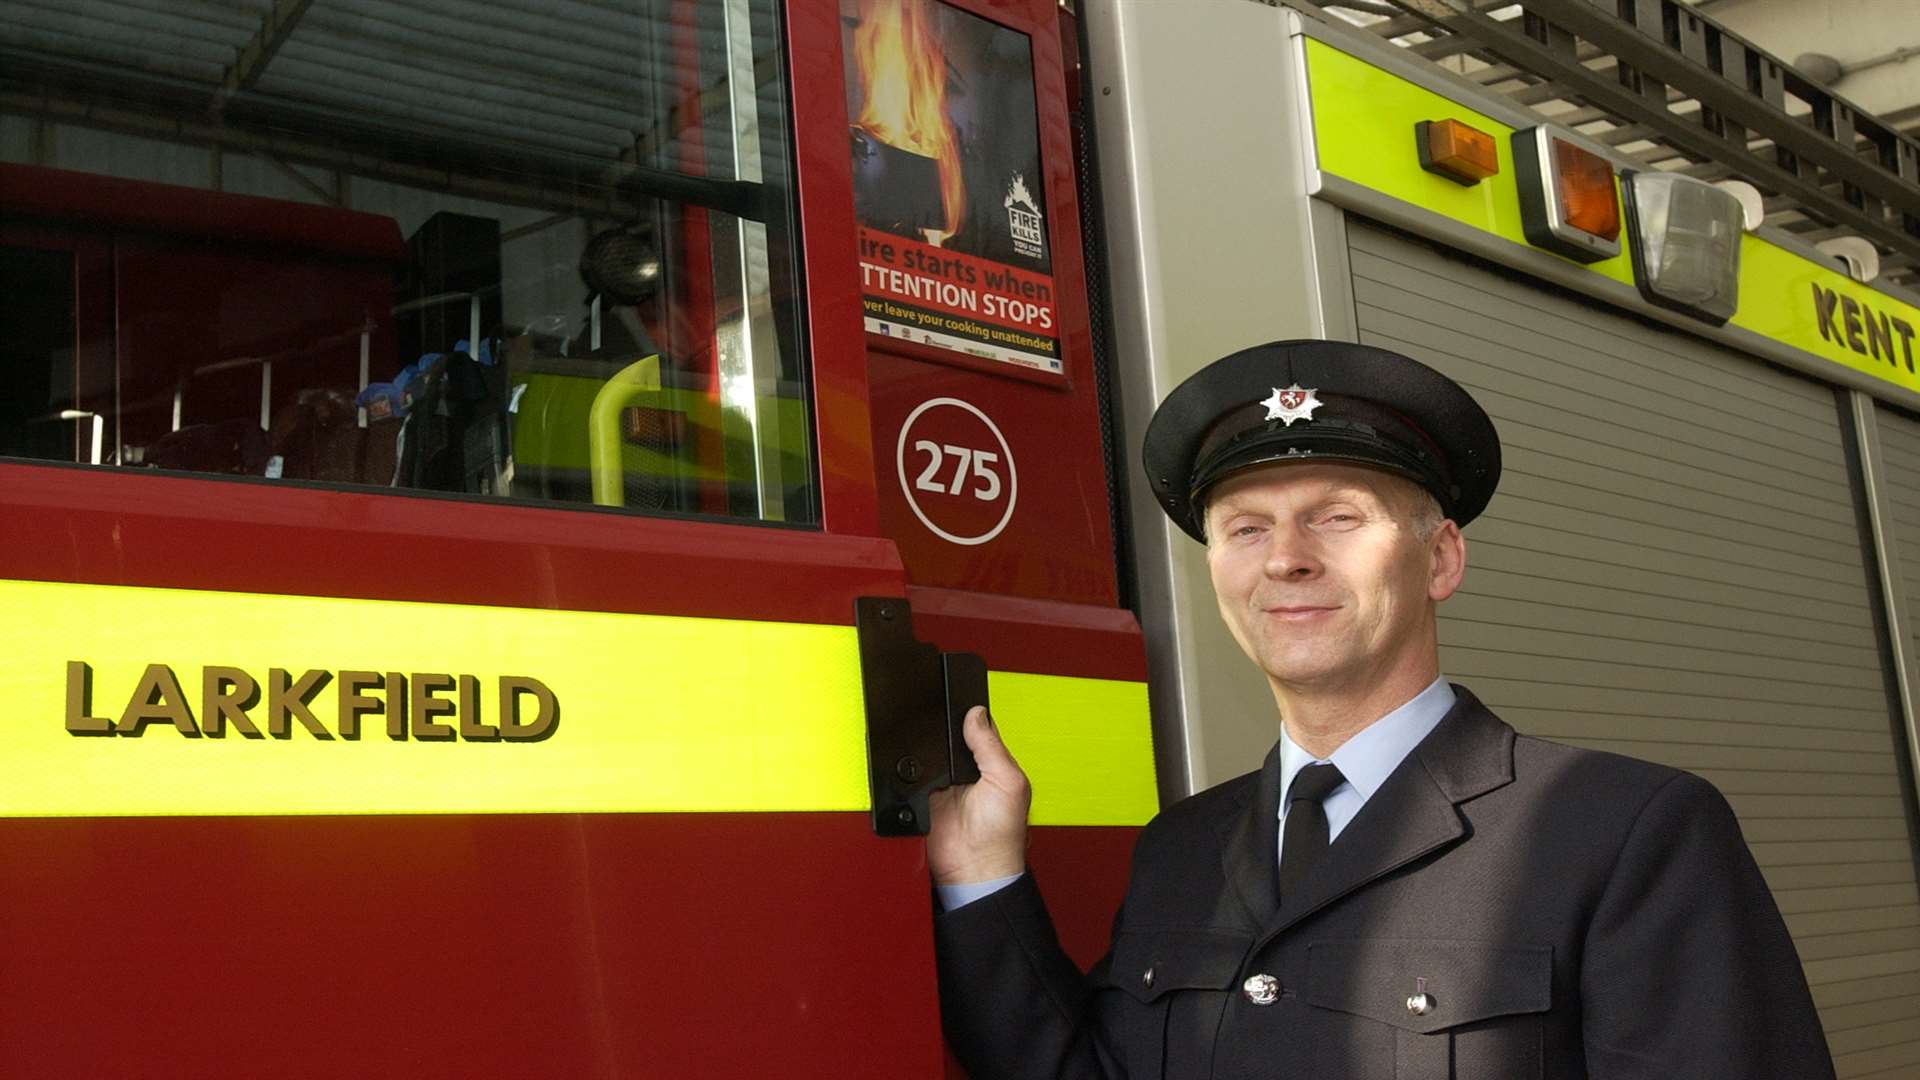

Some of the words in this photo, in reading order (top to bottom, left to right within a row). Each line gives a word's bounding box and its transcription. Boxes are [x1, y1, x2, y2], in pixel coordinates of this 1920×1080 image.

[1010, 210, 1039, 230] FIRE
[1012, 226, 1040, 242] KILLS
[903, 248, 977, 285] starts
[984, 269, 1052, 303] when
[884, 302, 917, 321] leave
[917, 312, 944, 326] your
[945, 319, 990, 340] cooking
[991, 329, 1054, 351] unattended
[983, 293, 1052, 329] STOPS
[1811, 281, 1916, 375] KENT
[915, 440, 1001, 501] 275
[64, 660, 561, 743] LARKFIELD
